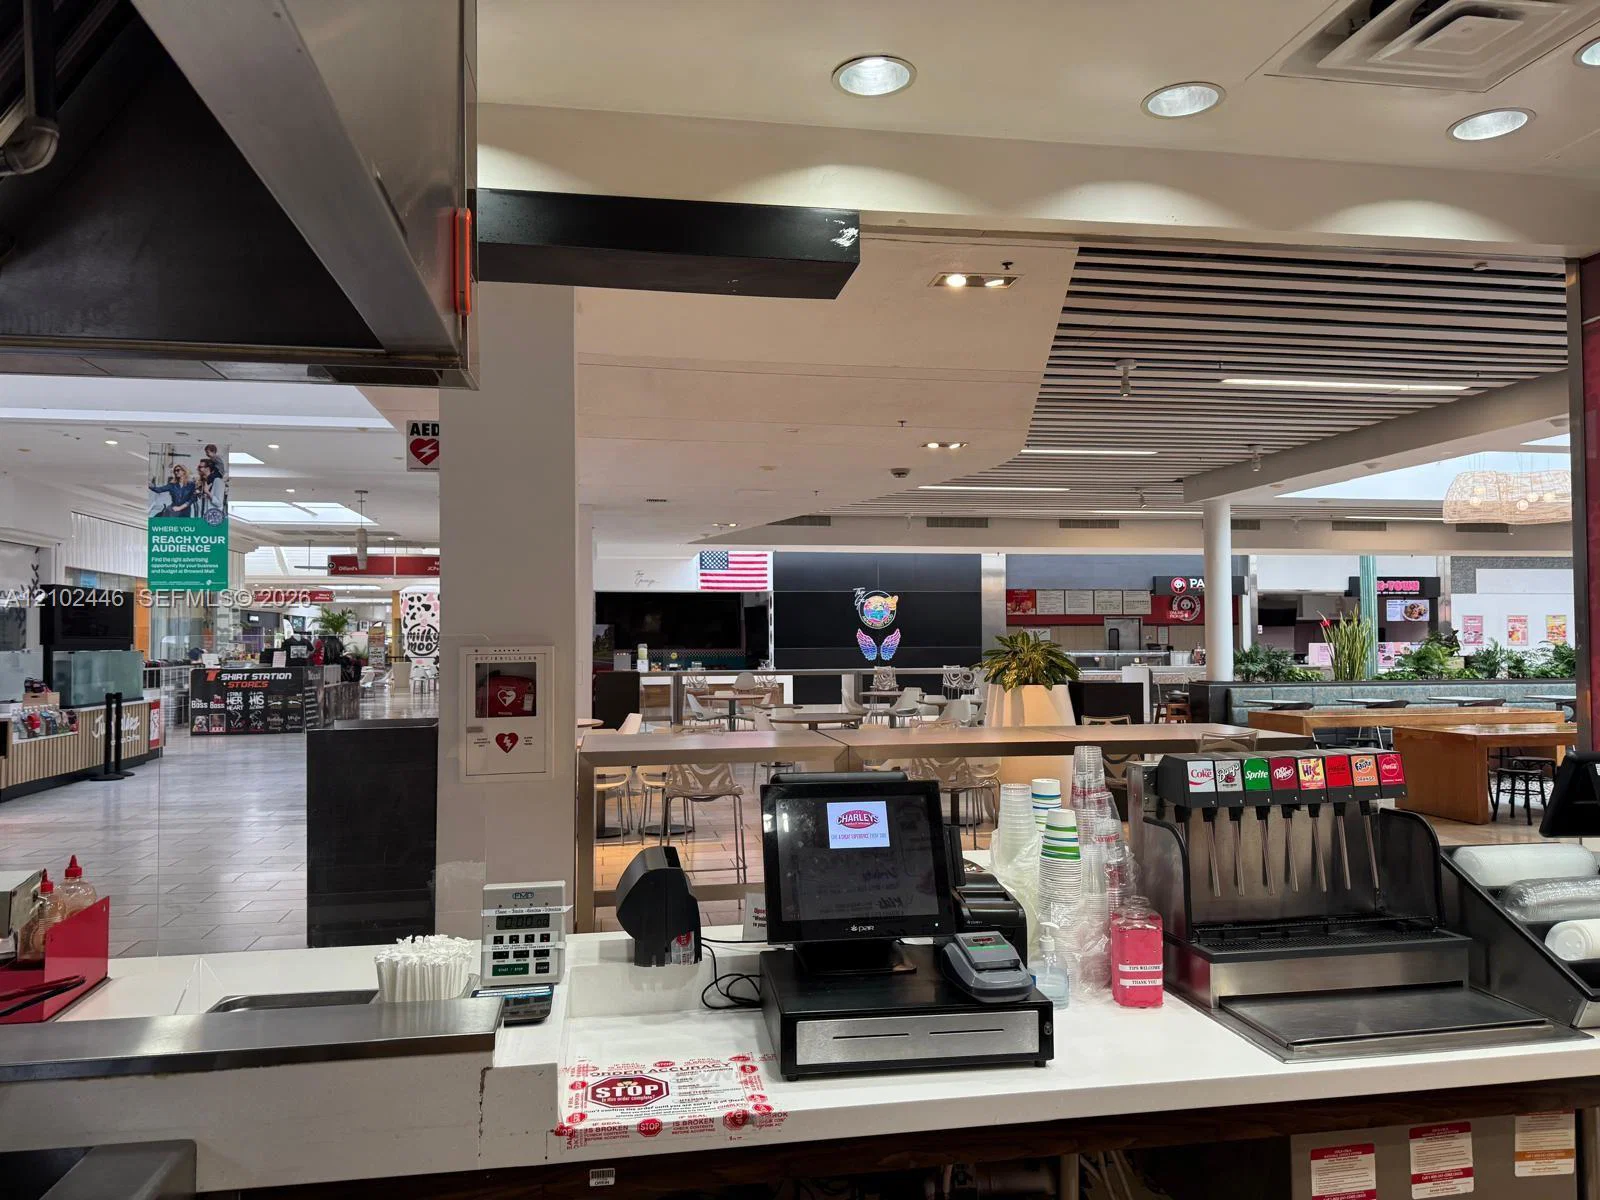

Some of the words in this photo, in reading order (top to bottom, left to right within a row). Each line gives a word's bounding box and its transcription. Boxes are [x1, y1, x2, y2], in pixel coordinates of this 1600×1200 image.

[410, 422, 439, 436] AED
[151, 535, 191, 544] REACH
[193, 535, 226, 545] YOUR
[151, 544, 211, 553] AUDIENCE
[1189, 578, 1205, 588] PA
[407, 628, 439, 644] milky
[408, 642, 433, 651] moo
[205, 670, 248, 682] T-SHIRT
[252, 672, 292, 680] STATION
[191, 700, 208, 708] Boss
[1190, 769, 1213, 779] Coke
[1245, 769, 1269, 780] Sprite
[590, 1069, 644, 1077] ORDER
[648, 1062, 731, 1074] ACCURACY
[595, 1084, 659, 1099] STOP
[640, 1122, 660, 1131] STOP
[682, 1118, 715, 1126] BROKEN
[595, 1124, 629, 1133] BROKEN
